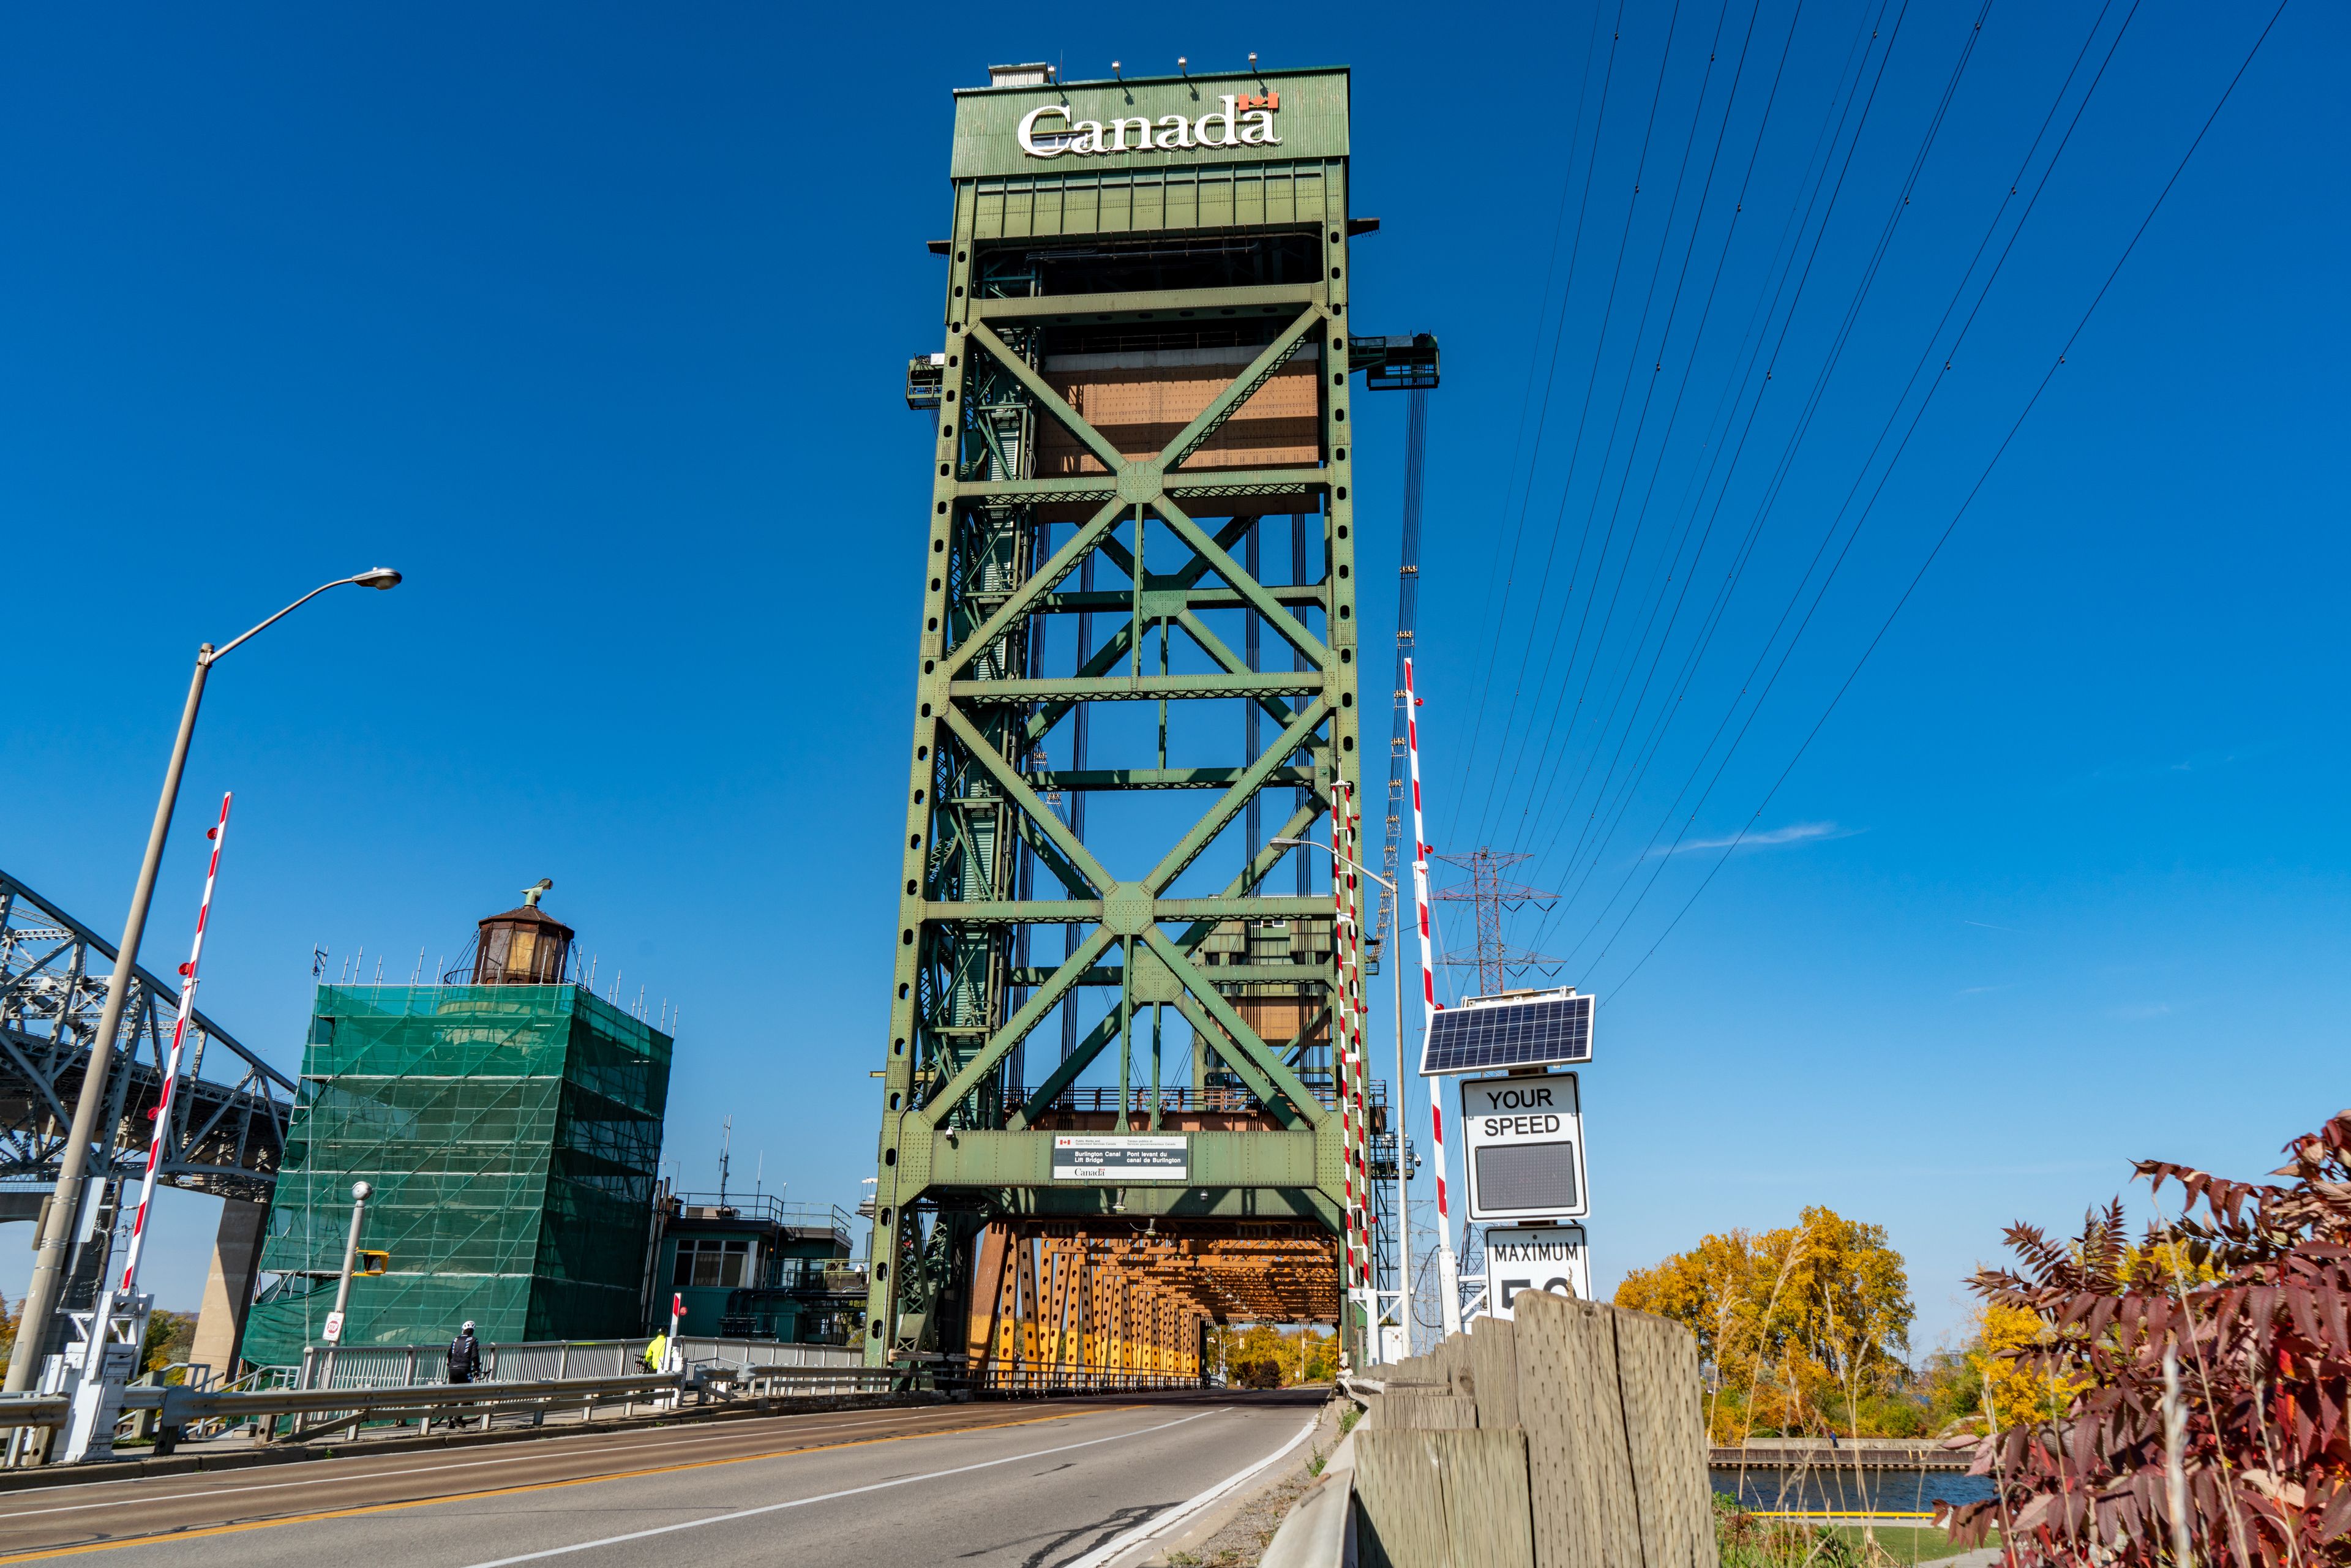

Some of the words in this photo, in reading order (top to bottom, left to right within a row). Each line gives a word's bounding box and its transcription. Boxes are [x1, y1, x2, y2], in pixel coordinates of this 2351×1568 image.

[1018, 95, 1281, 156] Canada
[1487, 1089, 1553, 1109] YOUR
[1485, 1115, 1560, 1136] SPEED
[1494, 1242, 1578, 1262] MAXIMUM
[328, 1322, 338, 1331] STOP
